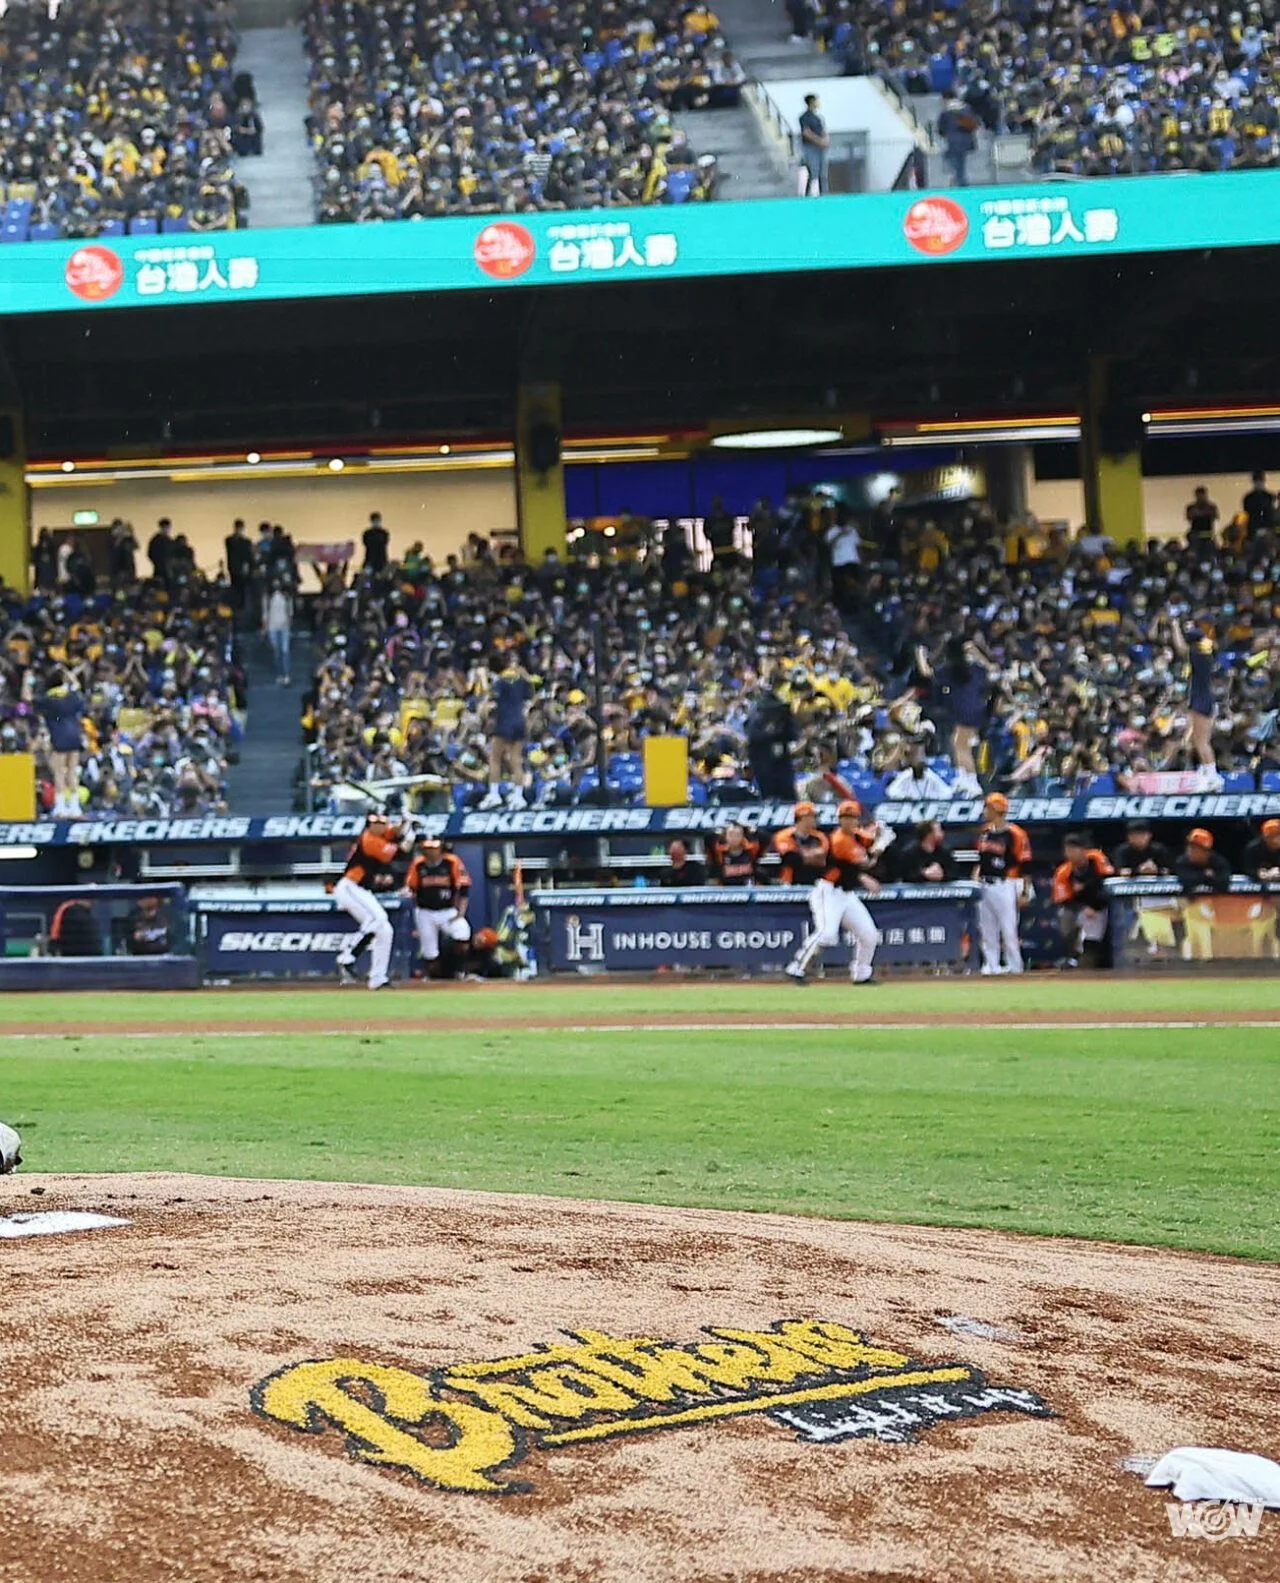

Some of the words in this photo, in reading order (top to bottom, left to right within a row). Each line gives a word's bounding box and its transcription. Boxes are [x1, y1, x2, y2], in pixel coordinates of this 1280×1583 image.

[66, 817, 252, 843] SKECHERS
[461, 808, 653, 834] SKECHERS
[613, 932, 712, 950] INHOUSE
[719, 931, 794, 949] GROUP
[254, 1318, 912, 1492] Brothers
[774, 1403, 921, 1441] Light
[905, 1393, 963, 1415] it
[962, 1387, 1044, 1411] up
